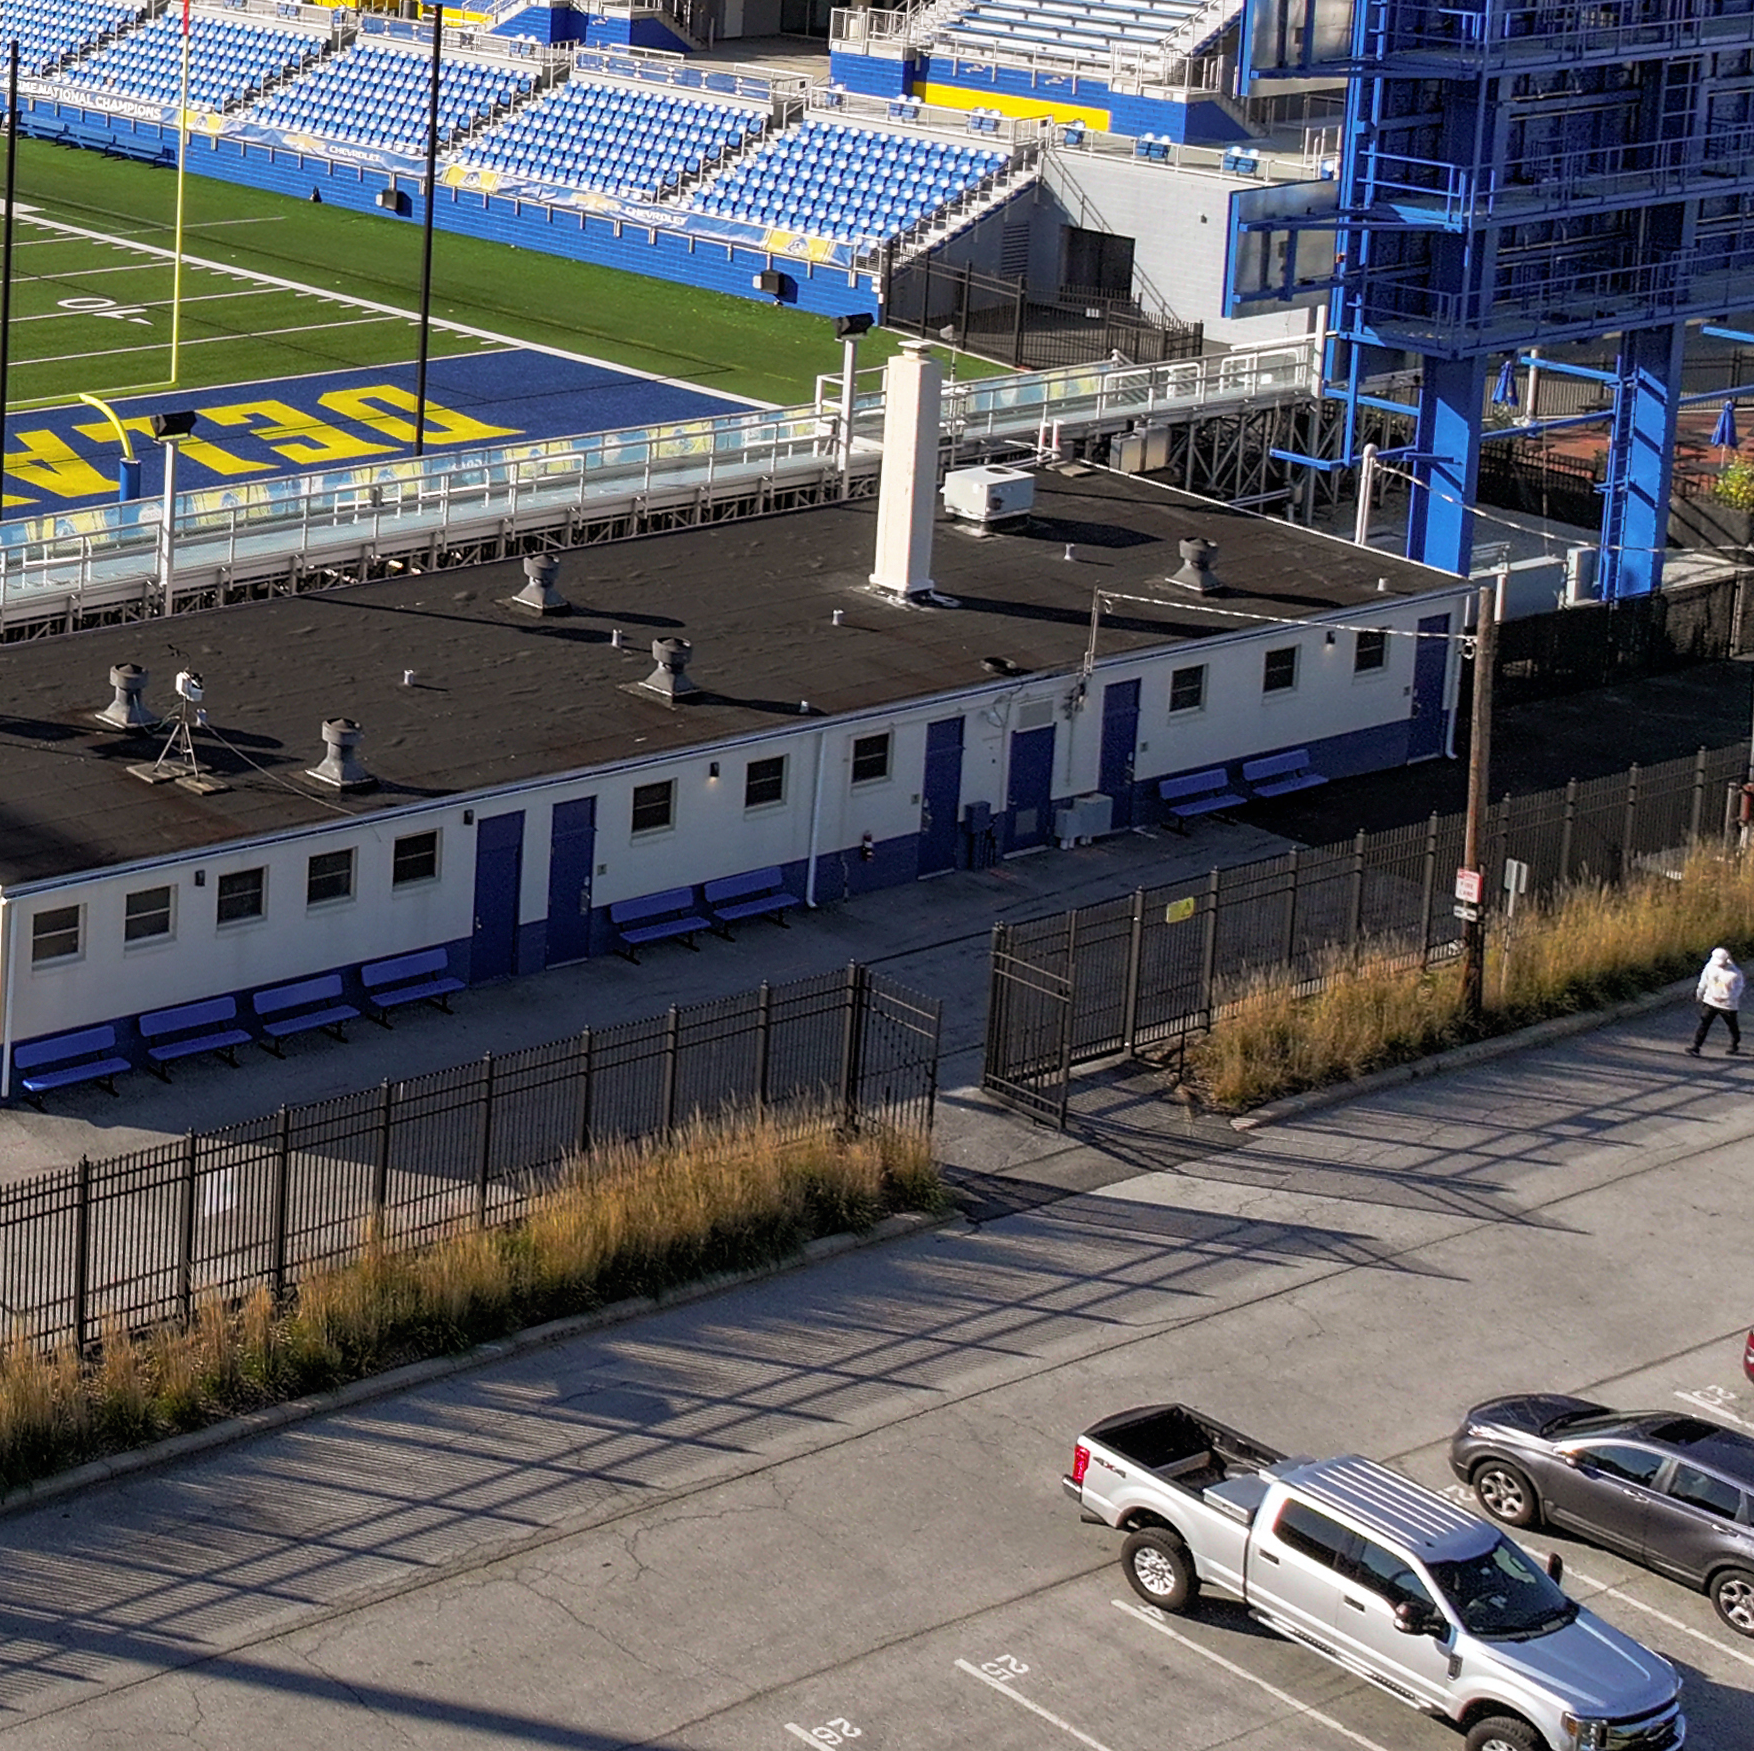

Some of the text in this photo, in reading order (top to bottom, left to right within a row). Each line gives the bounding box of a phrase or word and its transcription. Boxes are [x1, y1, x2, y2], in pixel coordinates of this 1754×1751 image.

[39, 84, 92, 108] NATIONAL
[96, 95, 162, 120] CHAMPIONS
[625, 206, 688, 226] CHEVROLET
[57, 297, 138, 319] 10
[980, 1654, 1030, 1682] 25
[811, 1717, 863, 1745] 26
